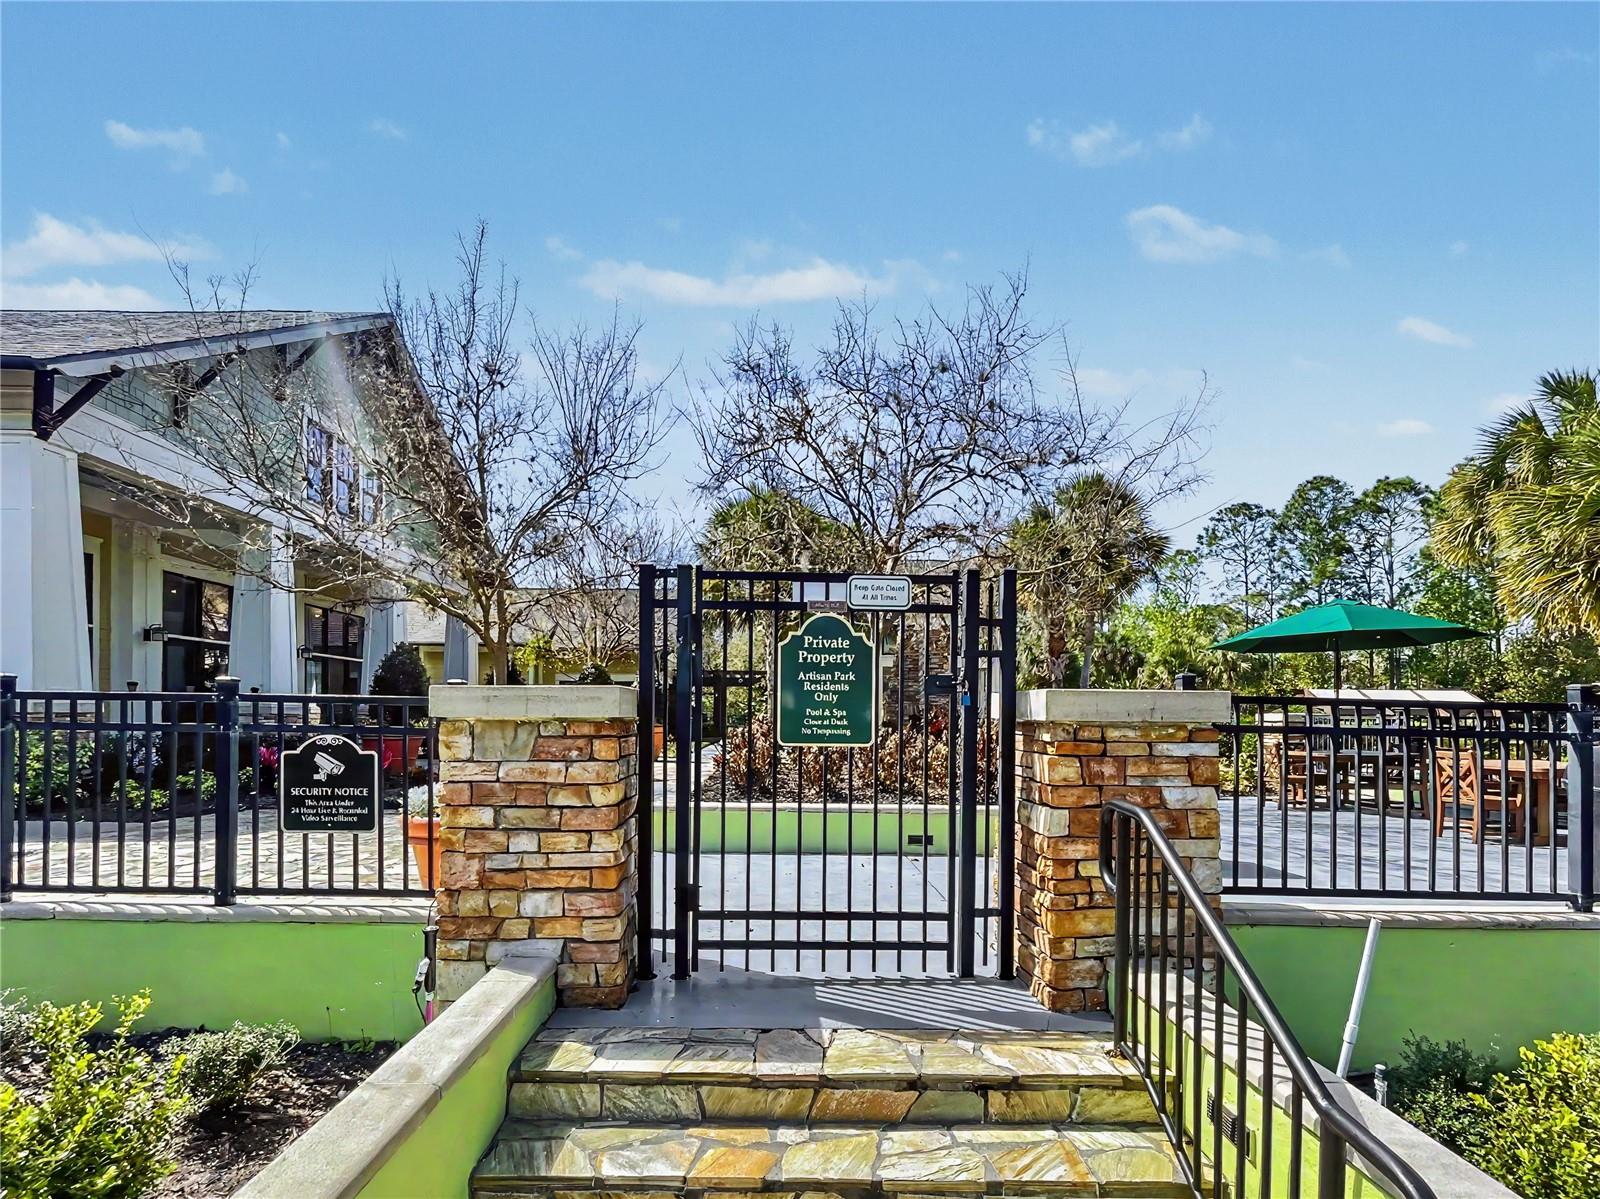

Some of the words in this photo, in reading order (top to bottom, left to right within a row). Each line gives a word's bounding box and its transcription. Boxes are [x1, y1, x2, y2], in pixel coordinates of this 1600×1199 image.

[870, 584, 884, 592] Gate
[885, 584, 905, 592] Closed
[803, 635, 850, 648] Private
[798, 650, 855, 667] Property
[797, 671, 832, 681] Artisan
[834, 671, 856, 681] Park
[803, 681, 850, 691] Residents
[814, 692, 839, 704] Only
[806, 708, 823, 716] Pool
[832, 708, 847, 718] Spa
[812, 728, 851, 736] Trespassing
[290, 787, 332, 796] SECURITY
[334, 787, 369, 796] NOTICE
[305, 799, 318, 807] This
[334, 799, 354, 807] Under
